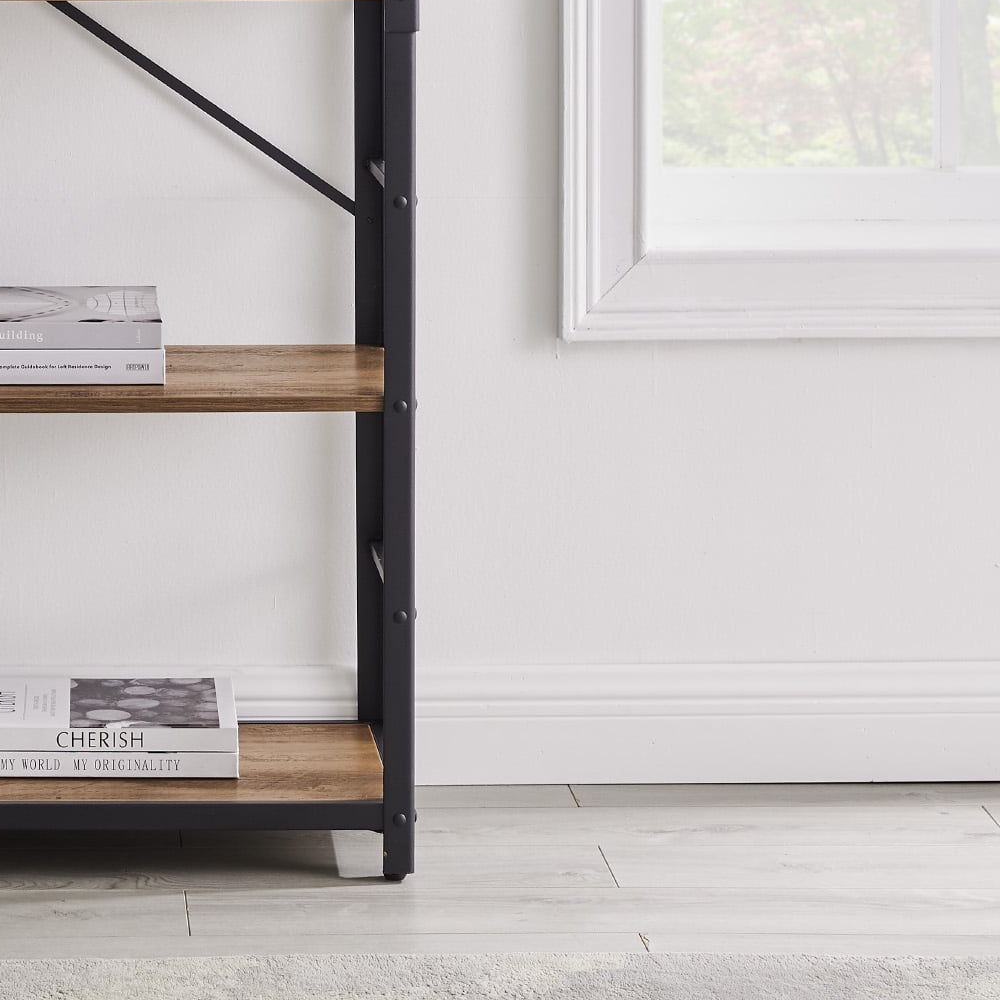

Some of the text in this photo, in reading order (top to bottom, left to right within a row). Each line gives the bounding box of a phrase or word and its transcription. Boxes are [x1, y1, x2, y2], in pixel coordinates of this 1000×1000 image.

[56, 731, 145, 748] CHERISH
[0, 758, 181, 771] MY WORLD MY ORIGINALITY
